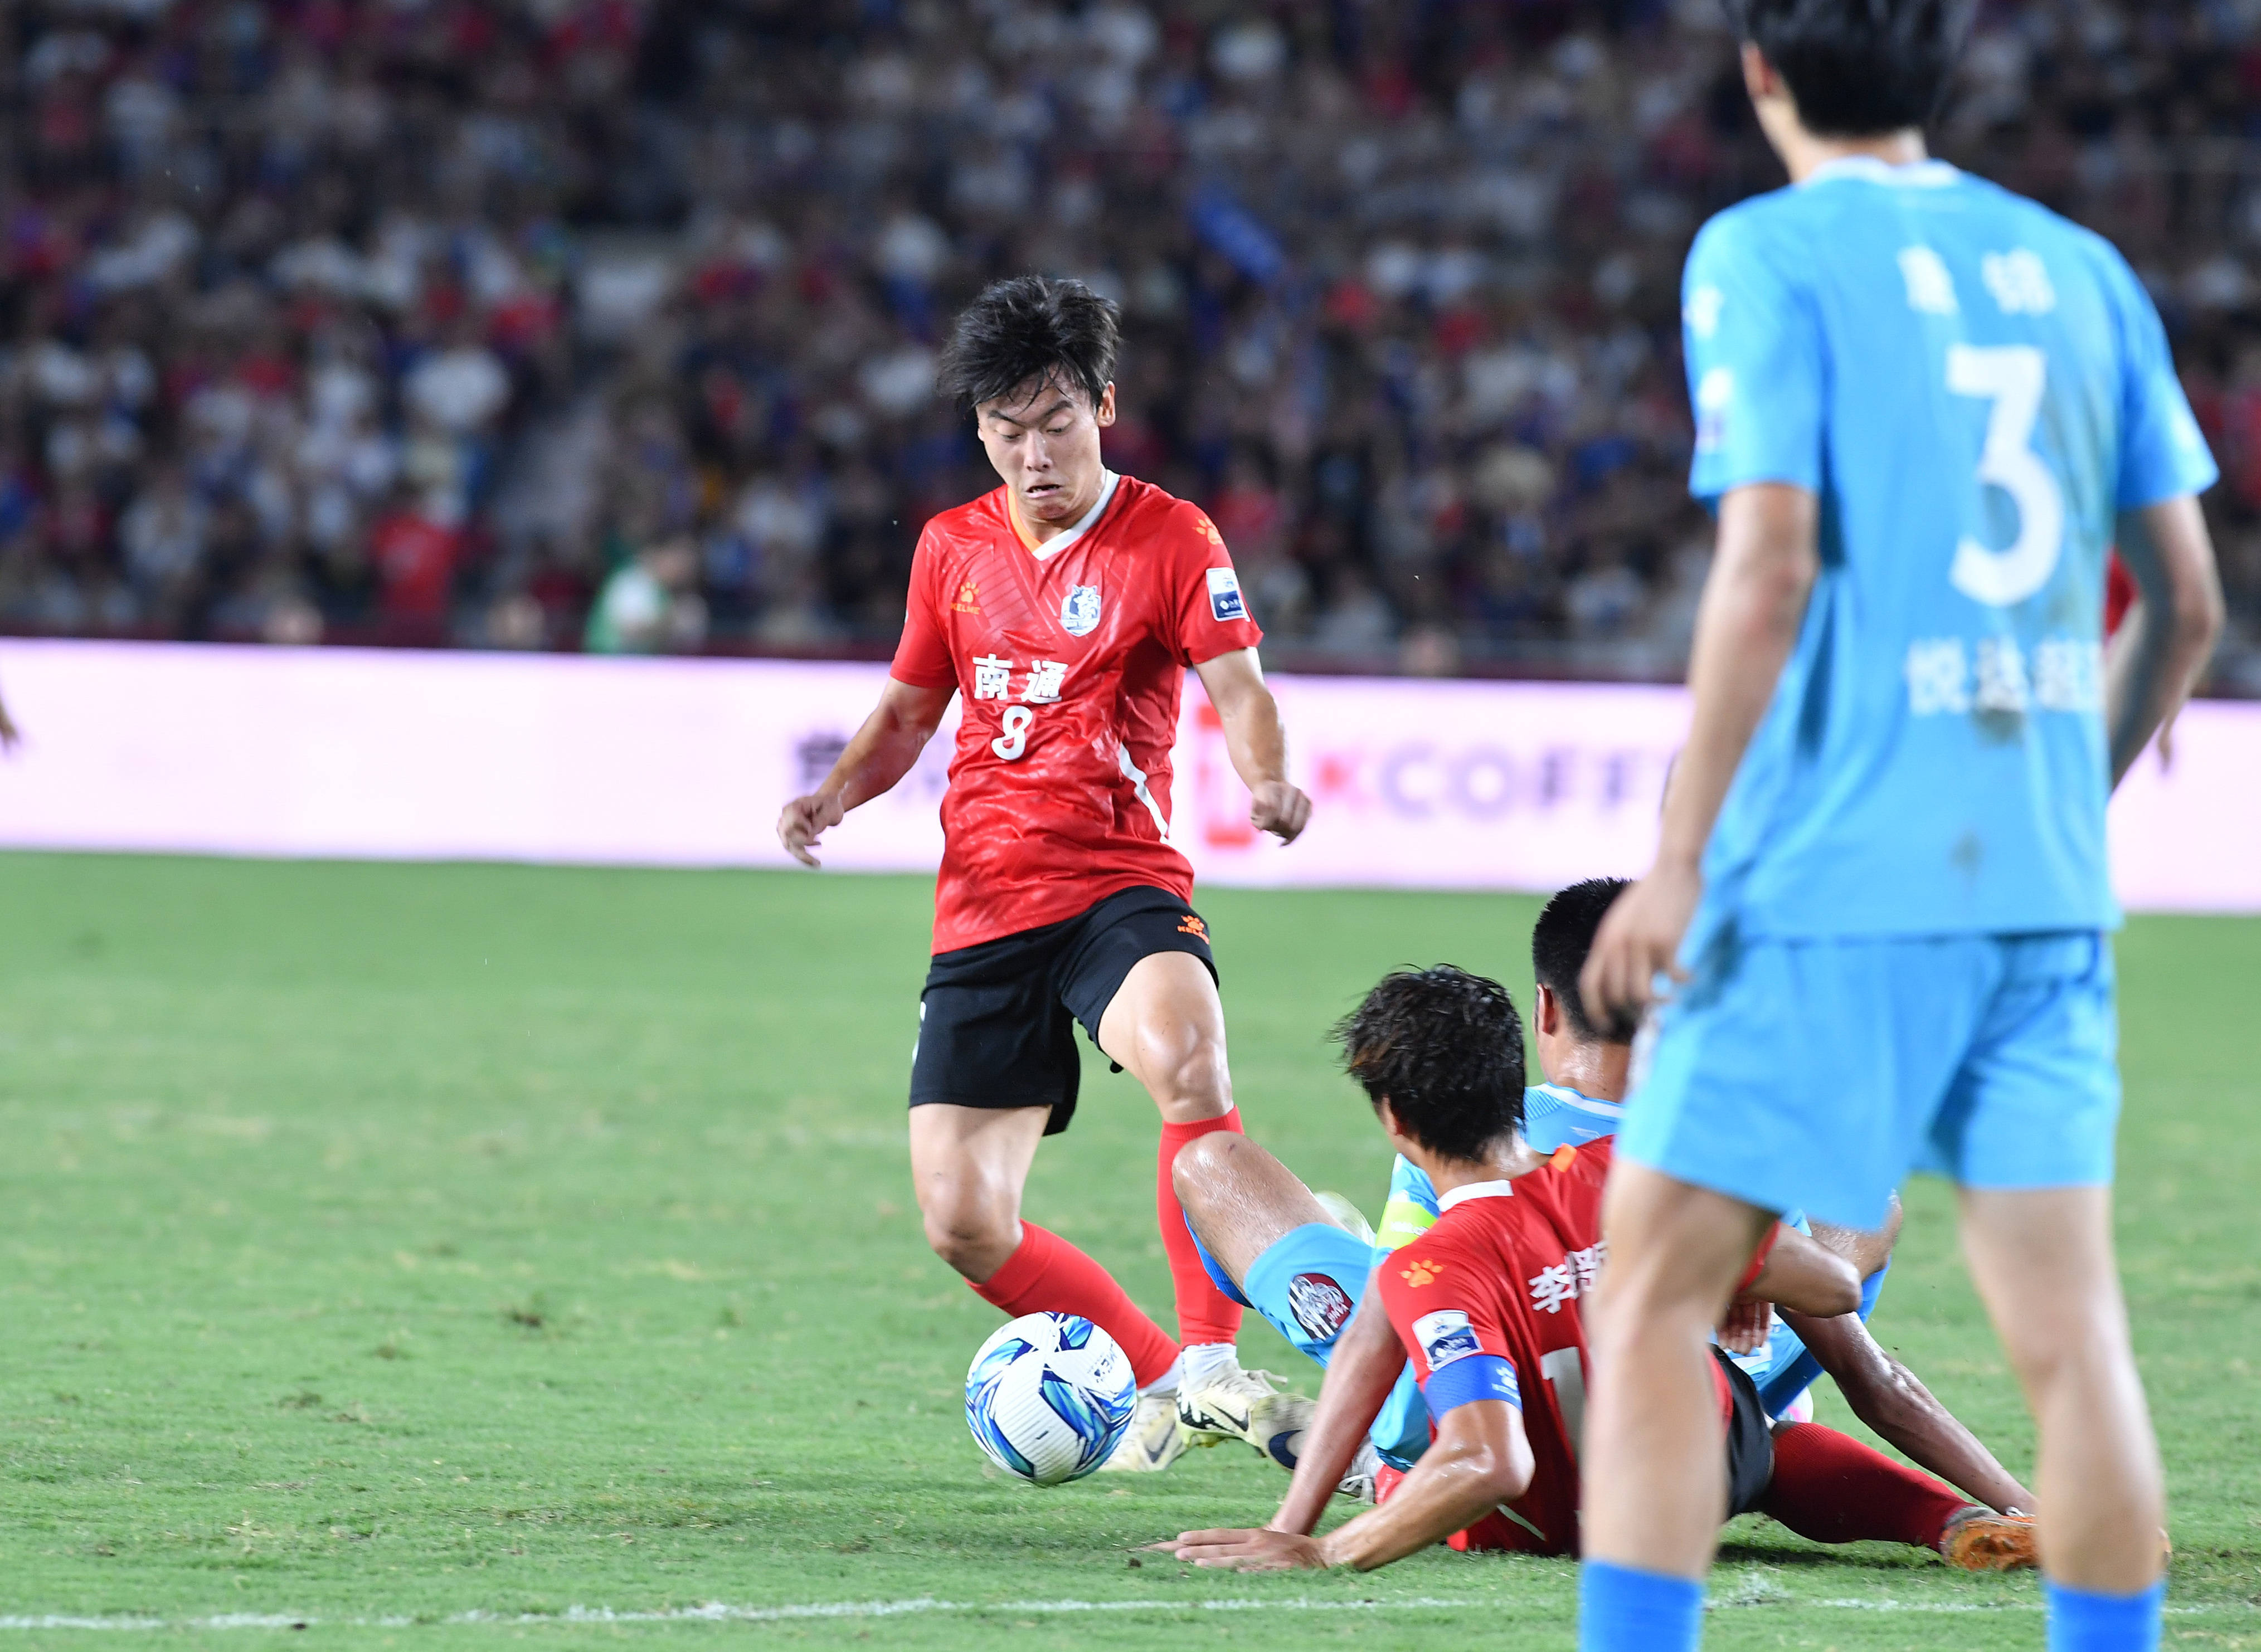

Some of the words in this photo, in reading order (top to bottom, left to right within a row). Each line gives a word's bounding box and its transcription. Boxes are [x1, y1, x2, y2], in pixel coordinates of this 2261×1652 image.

[1946, 344, 2063, 607] 3
[973, 653, 1068, 704] 南通
[991, 705, 1033, 761] 8
